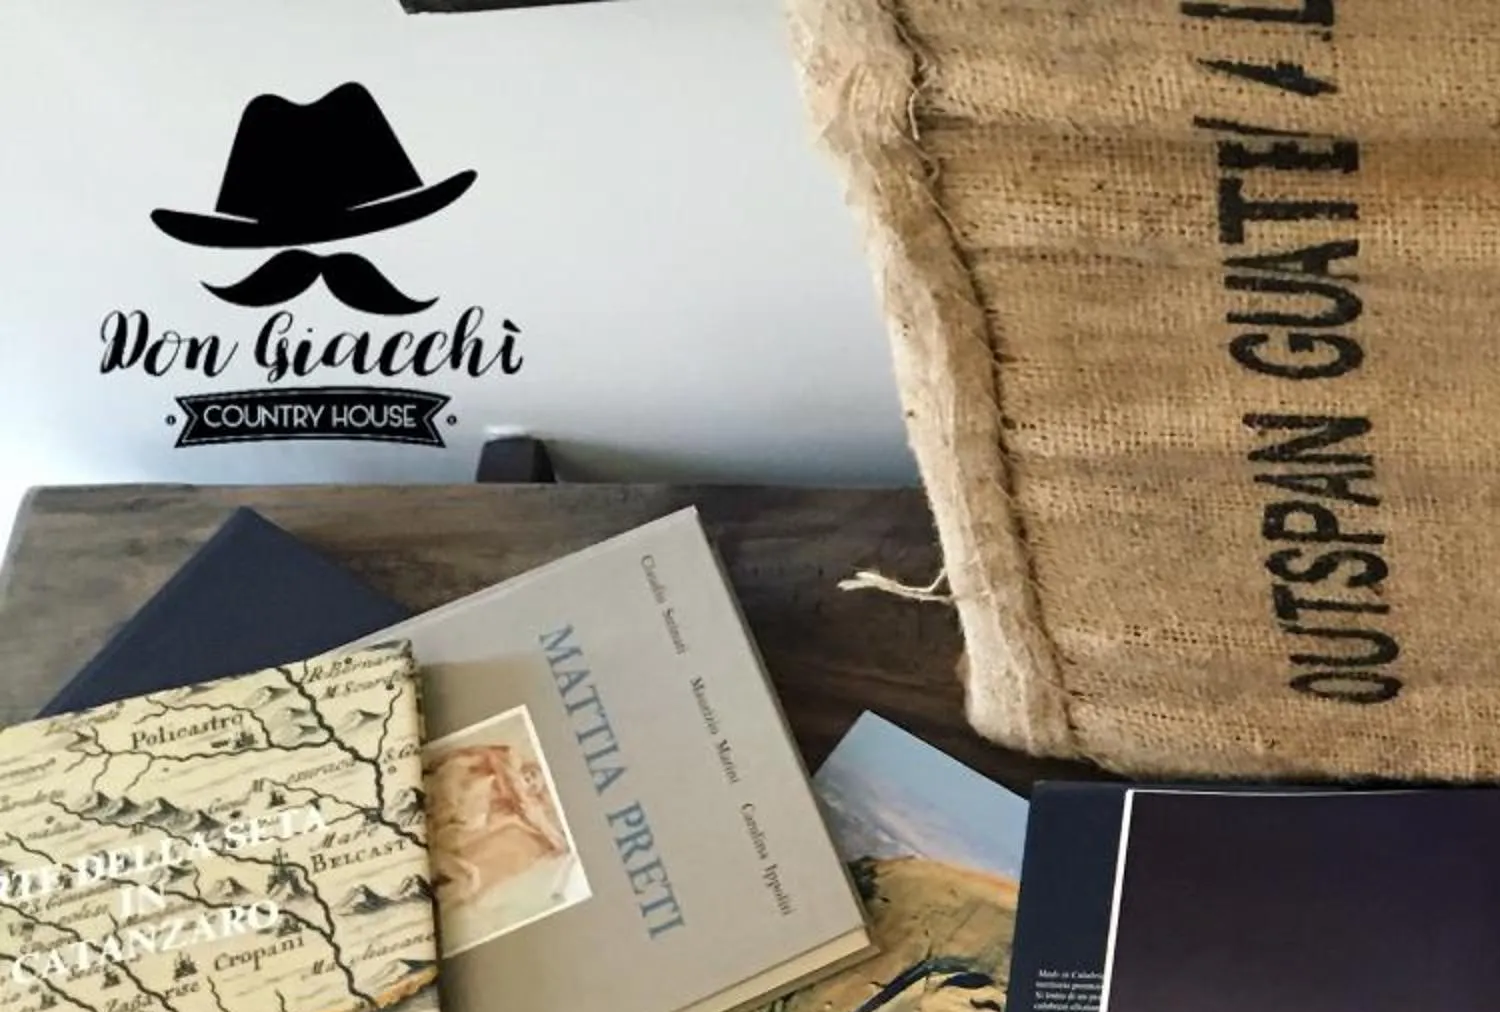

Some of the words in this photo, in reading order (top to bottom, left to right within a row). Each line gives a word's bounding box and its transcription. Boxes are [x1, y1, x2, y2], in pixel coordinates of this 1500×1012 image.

[1242, 412, 1402, 704] OUTSPAN
[130, 713, 244, 750] Policastro
[539, 624, 628, 797] MATTIA
[607, 801, 686, 939] PRETI
[11, 900, 280, 985] CATANZARO
[214, 937, 305, 972] Cropani
